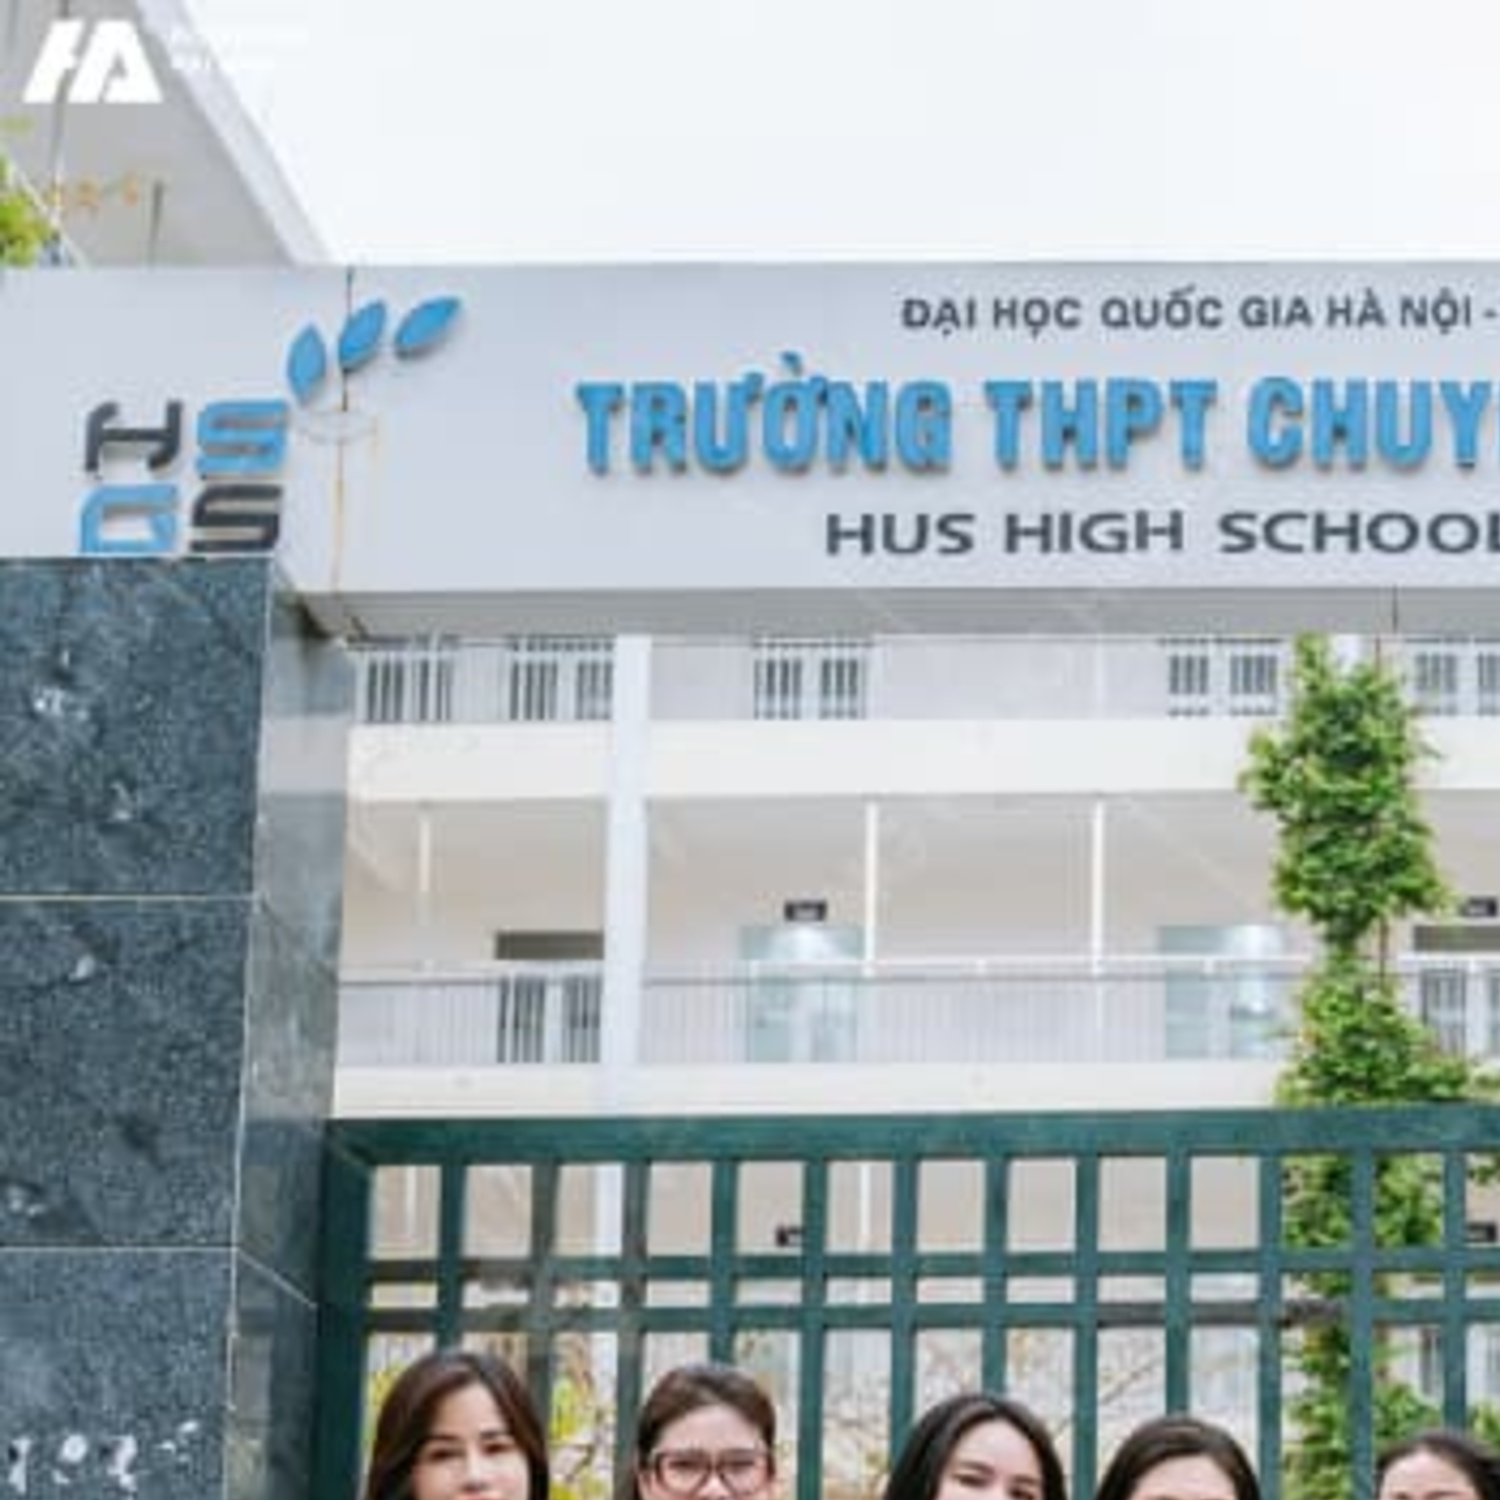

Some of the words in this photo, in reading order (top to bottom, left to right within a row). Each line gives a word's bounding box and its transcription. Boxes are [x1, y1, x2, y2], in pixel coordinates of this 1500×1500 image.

[902, 298, 977, 337] ĐẠI
[992, 297, 1082, 339] HỌC
[1100, 285, 1223, 330] QUỐC
[1238, 296, 1313, 329] GIA
[1326, 287, 1387, 328] HÀ
[1400, 288, 1473, 335] NỘI
[574, 350, 953, 472] TRƯỜNG
[983, 376, 1219, 469] THPT
[826, 513, 976, 556] HUS
[1004, 511, 1184, 555] HIGH
